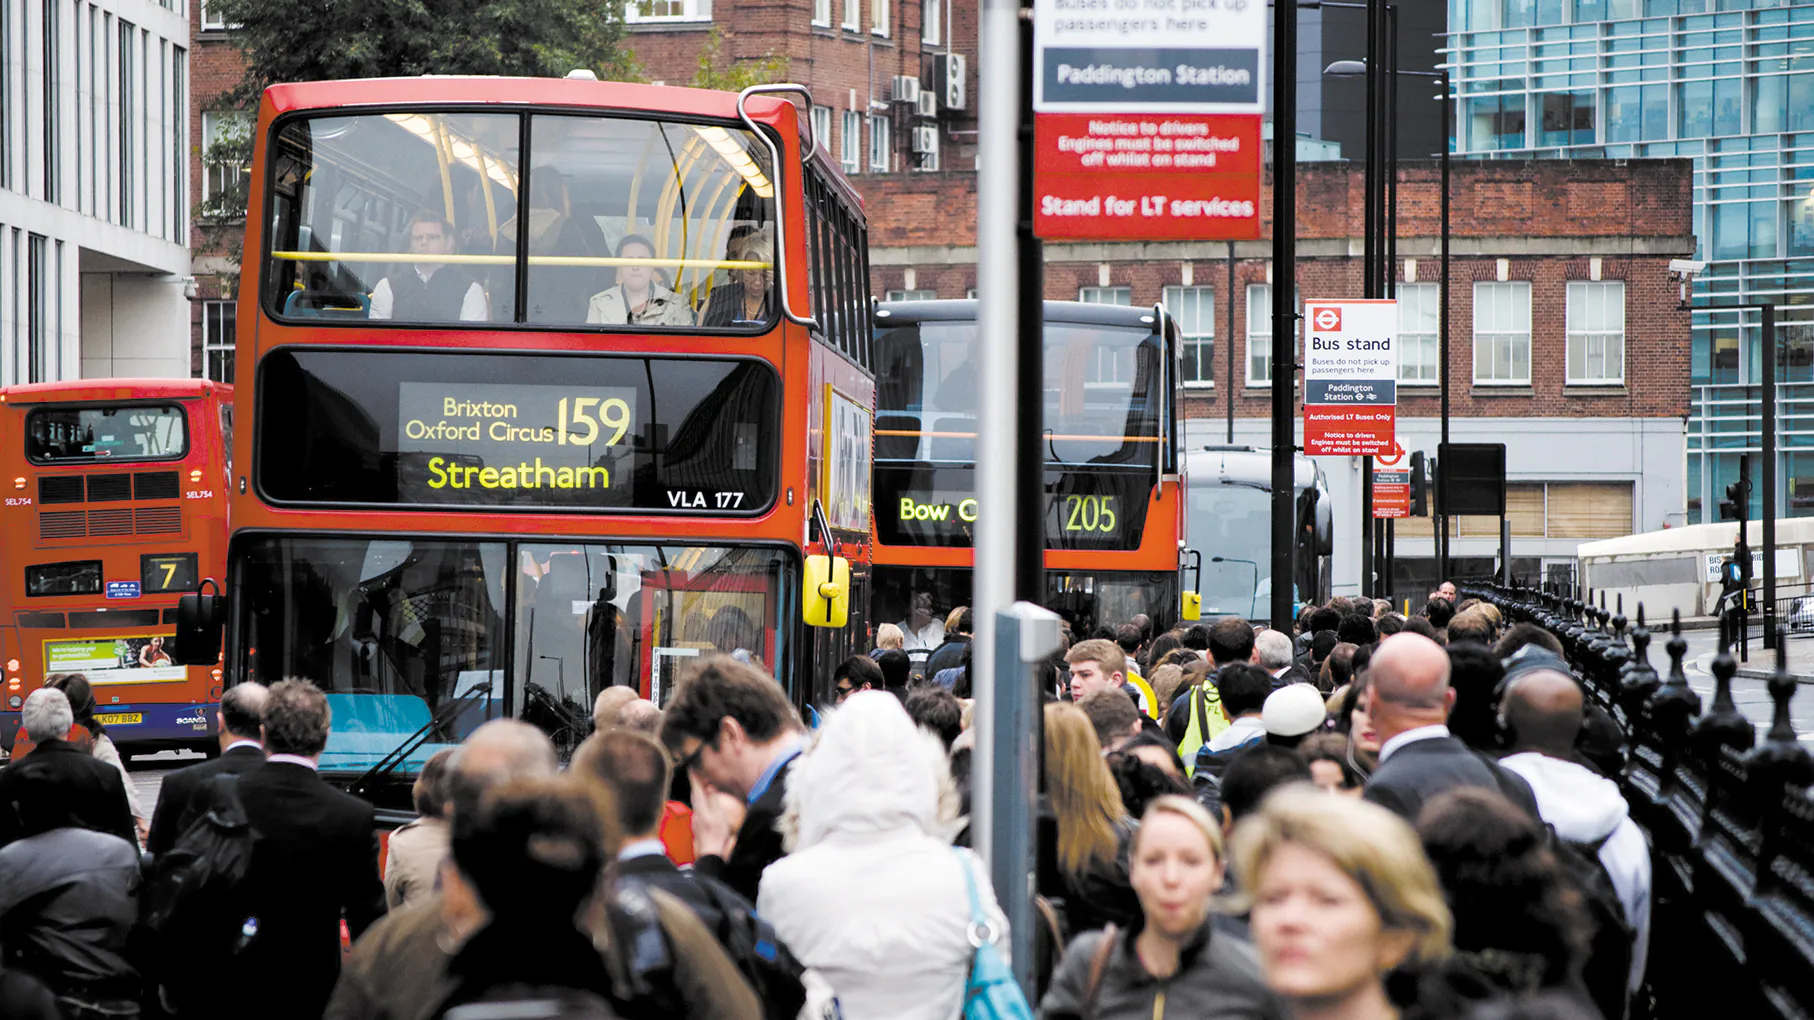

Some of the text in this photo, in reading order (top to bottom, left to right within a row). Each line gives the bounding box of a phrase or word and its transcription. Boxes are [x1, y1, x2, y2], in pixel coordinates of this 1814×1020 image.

[1114, 0, 1136, 10] do
[1143, 0, 1176, 10] not
[1182, 0, 1216, 13] pick
[1223, 0, 1247, 13] up
[1054, 15, 1208, 34] passengers here
[1057, 63, 1251, 88] Paddington Station
[1088, 120, 1209, 135] Notice to drivers
[1058, 135, 1240, 154] Engines must be switched
[1081, 152, 1216, 167] off whilst on stand
[1041, 195, 1254, 217] Stand for LT services
[1312, 337, 1390, 350] Bus stand
[1363, 358, 1378, 367] pick
[1328, 384, 1374, 393] Paddington
[443, 397, 517, 418] Brixton
[405, 397, 631, 446] Oxford Circus 159
[1375, 413, 1391, 422] Only
[1311, 439, 1334, 447] Engines
[427, 457, 609, 488] Streatham
[5, 498, 32, 506] SEL754
[186, 490, 213, 499] SEL754
[667, 490, 744, 508] VLA 177
[900, 495, 1116, 532] Bow C 205
[160, 563, 177, 589] 7
